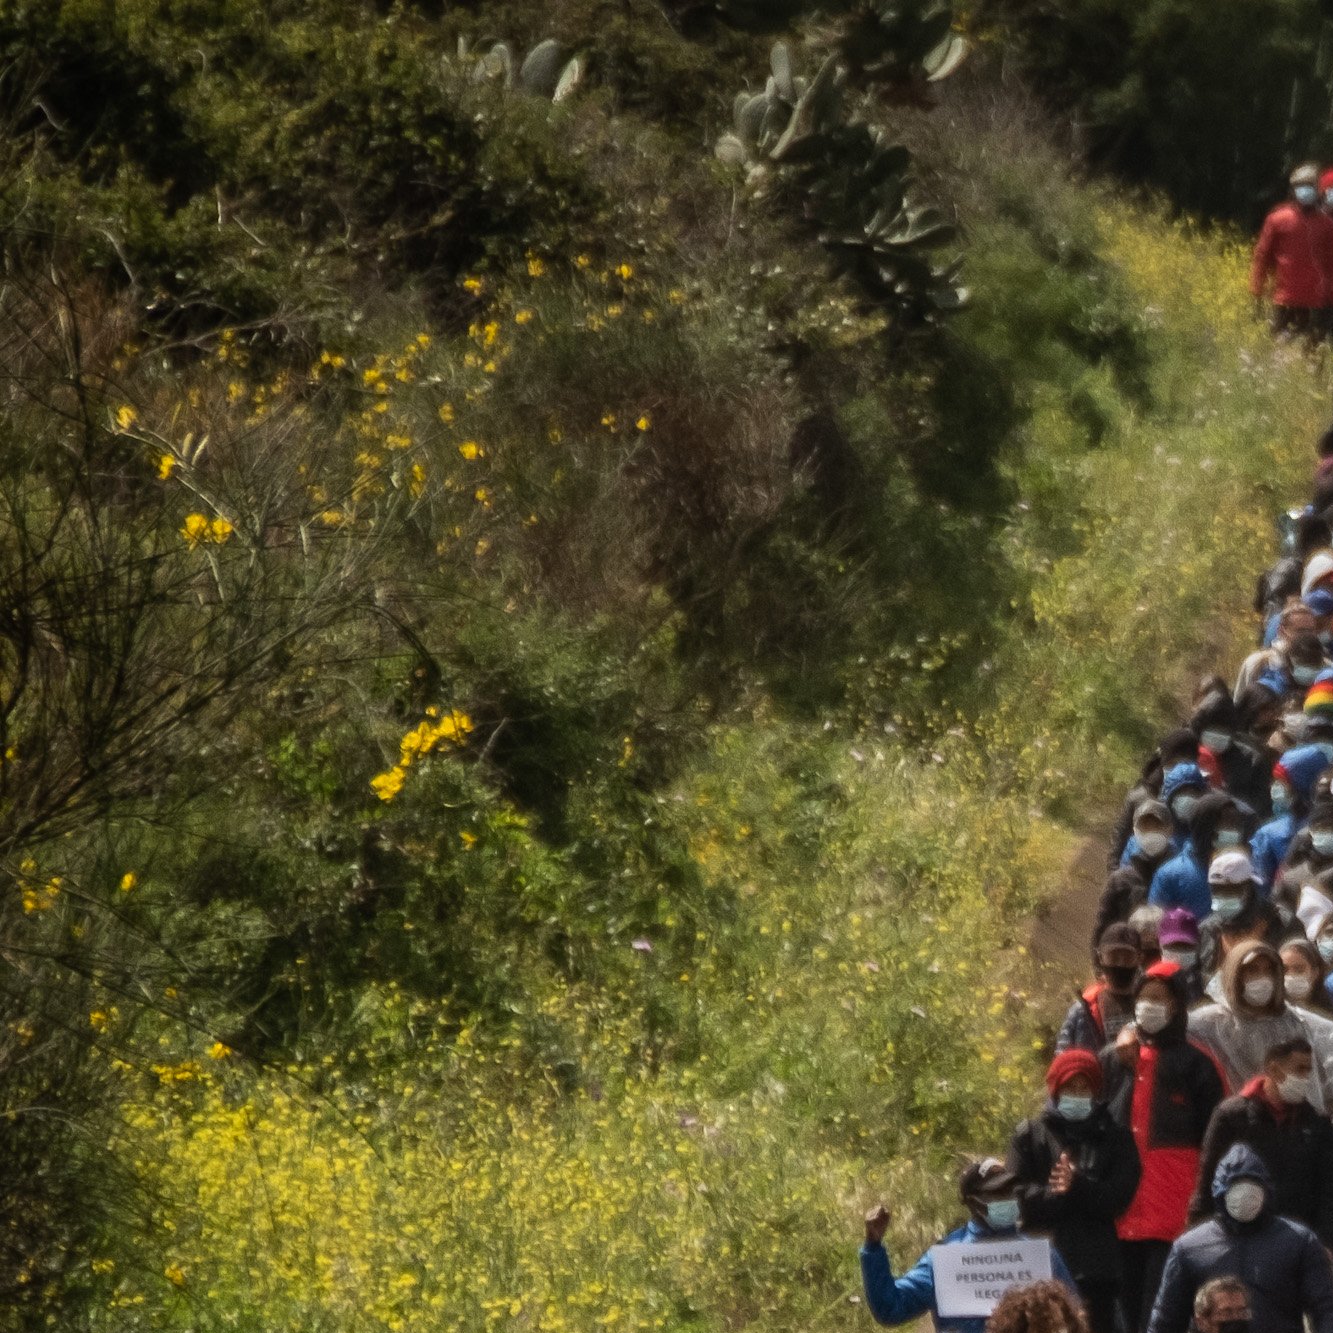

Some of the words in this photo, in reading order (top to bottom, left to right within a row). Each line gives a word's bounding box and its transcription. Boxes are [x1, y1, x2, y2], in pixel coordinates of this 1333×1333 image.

[961, 1253, 1024, 1266] NINGUNA
[955, 1271, 1015, 1283] PERSONA
[1017, 1270, 1032, 1281] ES
